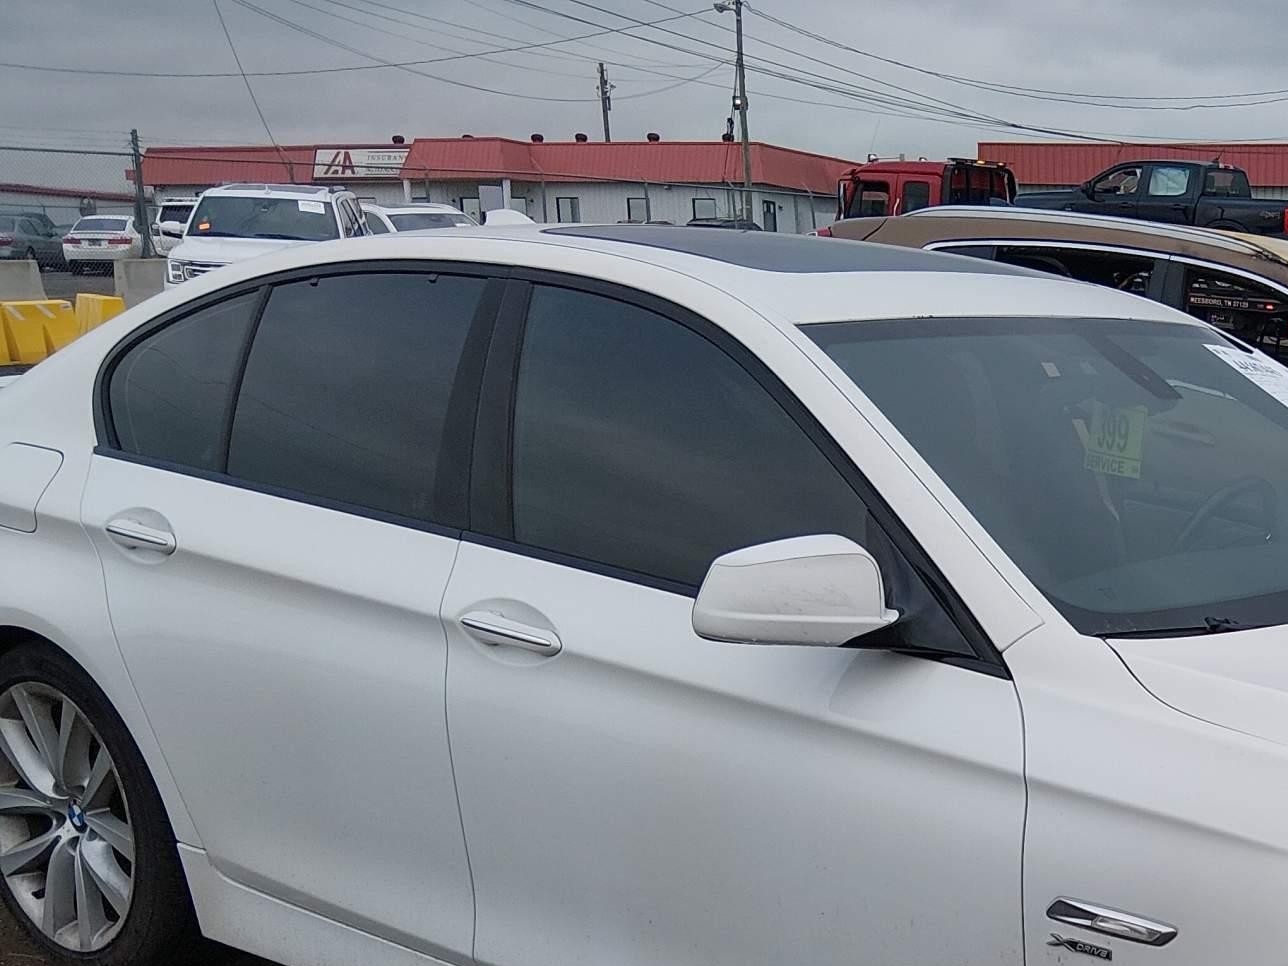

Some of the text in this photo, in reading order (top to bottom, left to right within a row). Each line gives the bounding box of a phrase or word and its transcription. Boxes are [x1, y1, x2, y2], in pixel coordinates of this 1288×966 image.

[367, 154, 405, 162] INSURAN
[1224, 299, 1232, 307] TN
[1086, 454, 1126, 474] SERVICE
